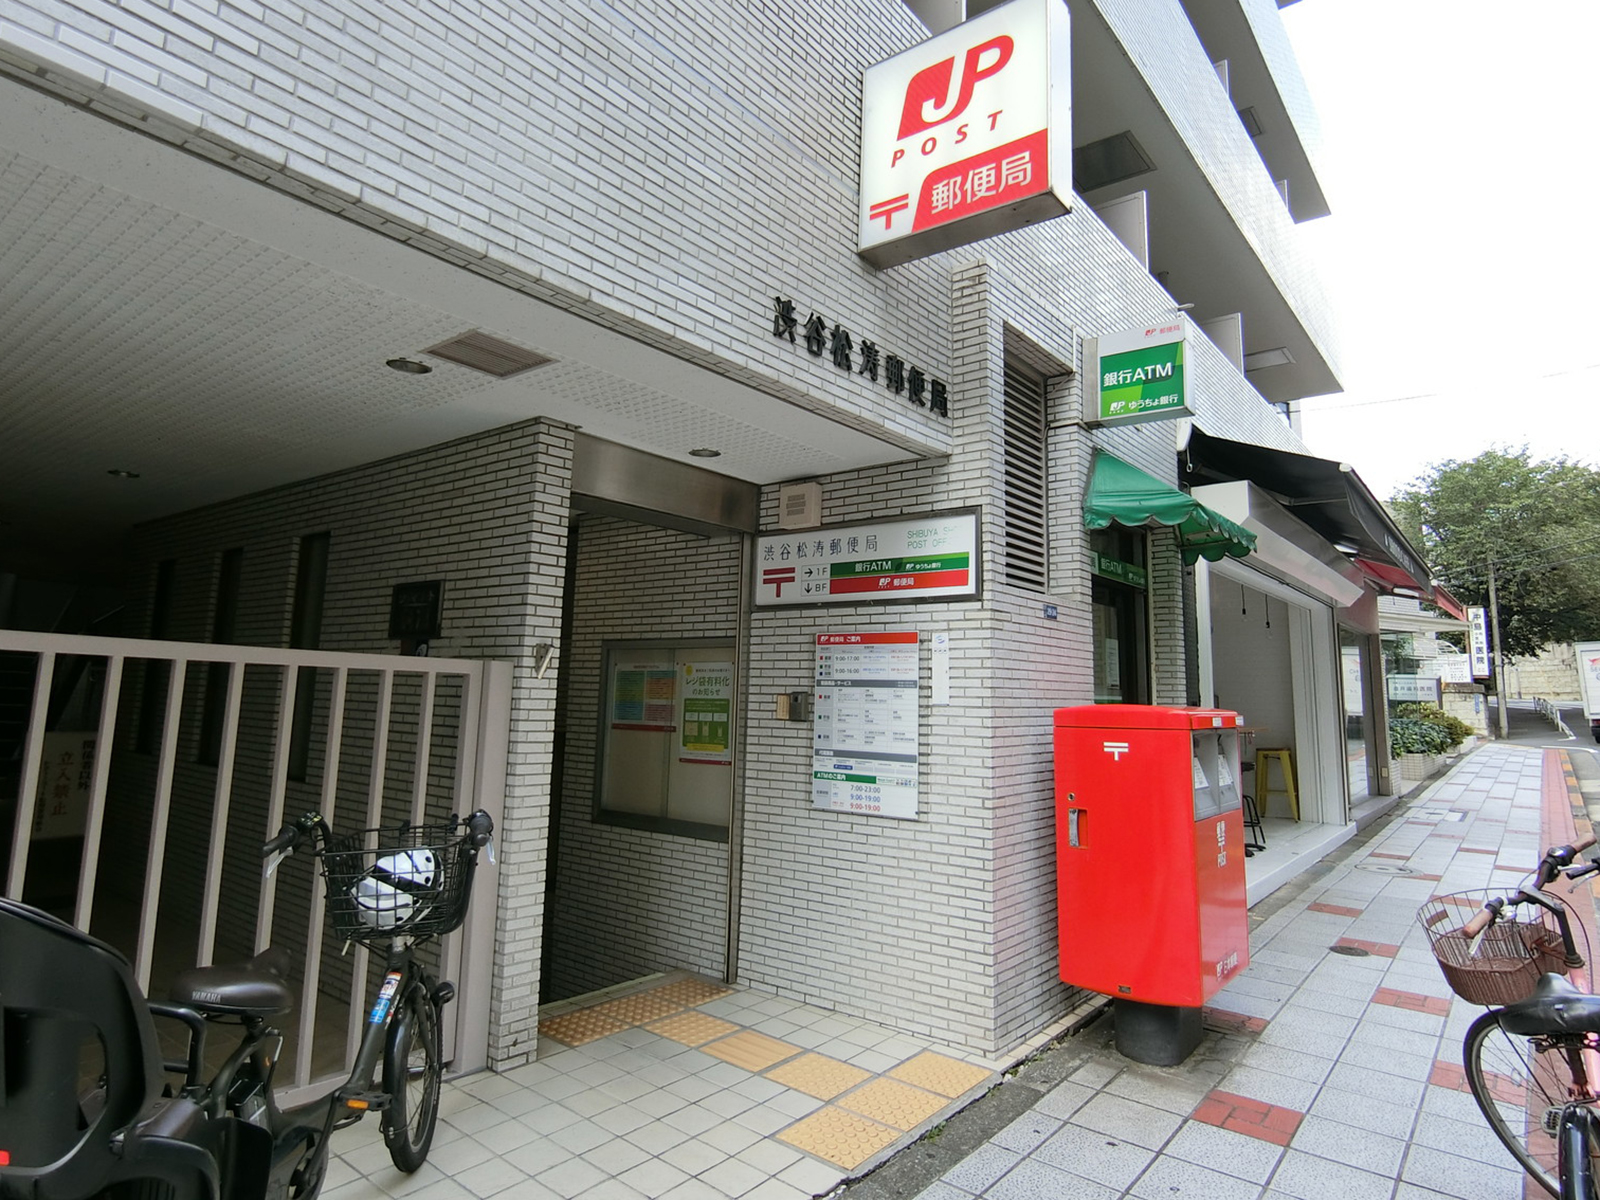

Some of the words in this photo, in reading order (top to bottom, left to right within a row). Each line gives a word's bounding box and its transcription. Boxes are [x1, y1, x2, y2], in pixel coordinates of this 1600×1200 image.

[891, 110, 1003, 168] POST
[931, 150, 1032, 214] 郵便局
[772, 296, 948, 418] 渋谷松涛郵便局
[1103, 362, 1172, 387] 銀行ATM
[1128, 393, 1178, 410] ゆうちょ銀行
[907, 529, 938, 539] SHIBUYA
[763, 534, 878, 561] 渋谷松涛郵便局
[907, 540, 927, 549] POST
[816, 567, 828, 576] 1F
[855, 560, 891, 572] 銀行ATM
[893, 577, 915, 587] 郵便局
[686, 675, 730, 687] レジ袋有料化
[850, 784, 881, 794] 7:00-23:00
[850, 793, 881, 803] 9:00-19:00
[850, 802, 881, 812] 9:00-19:00
[191, 990, 221, 1004] YAMAHA
